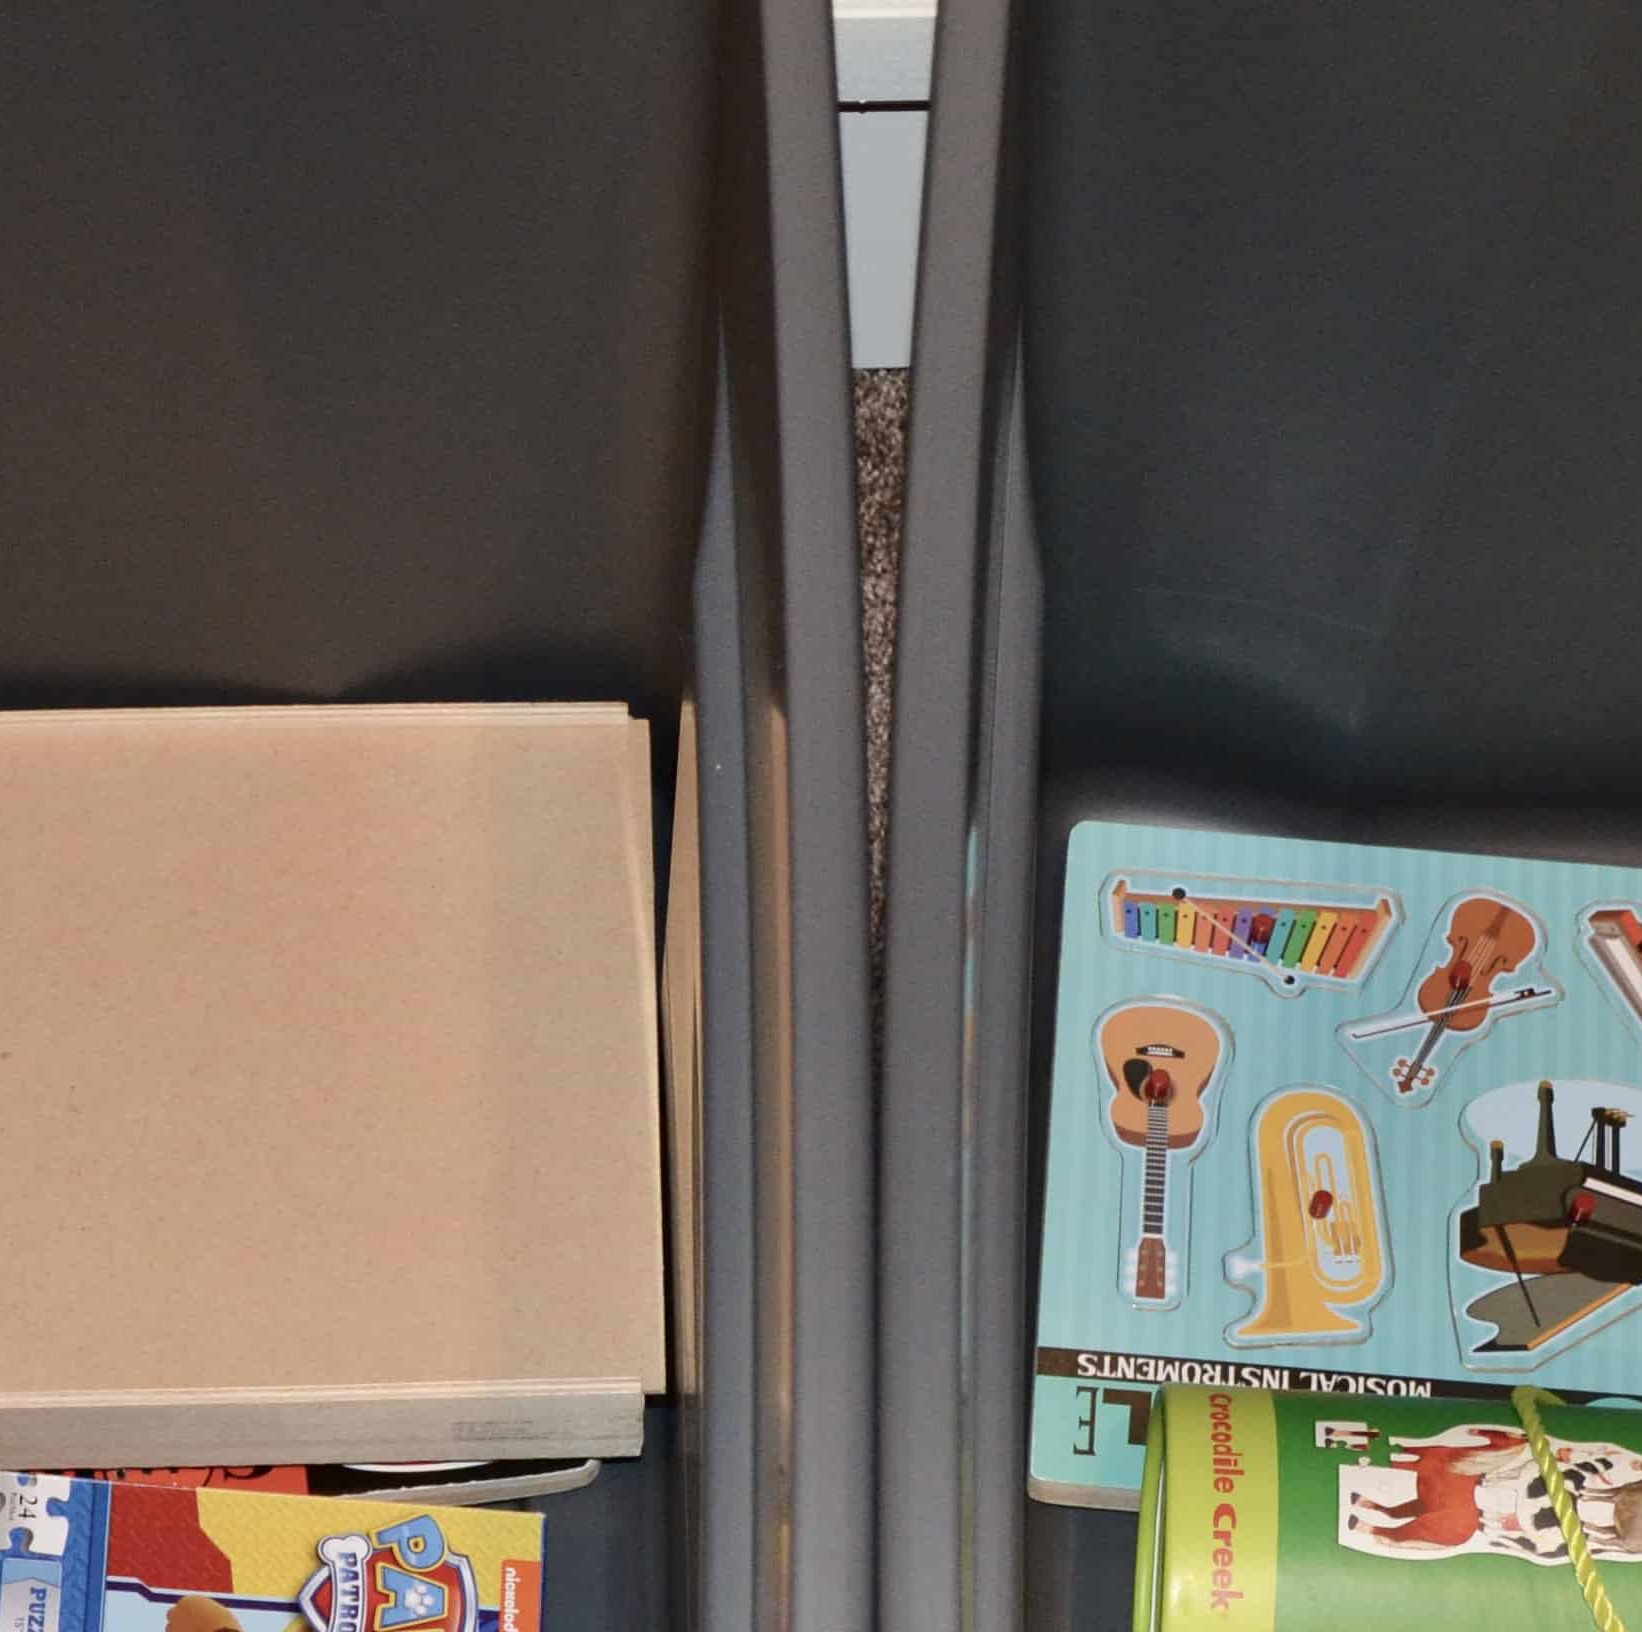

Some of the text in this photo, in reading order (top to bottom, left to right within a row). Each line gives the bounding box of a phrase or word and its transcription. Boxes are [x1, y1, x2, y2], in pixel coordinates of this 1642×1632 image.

[19, 1495, 38, 1519] 24
[1209, 1393, 1246, 1612] Crocodile Creek
